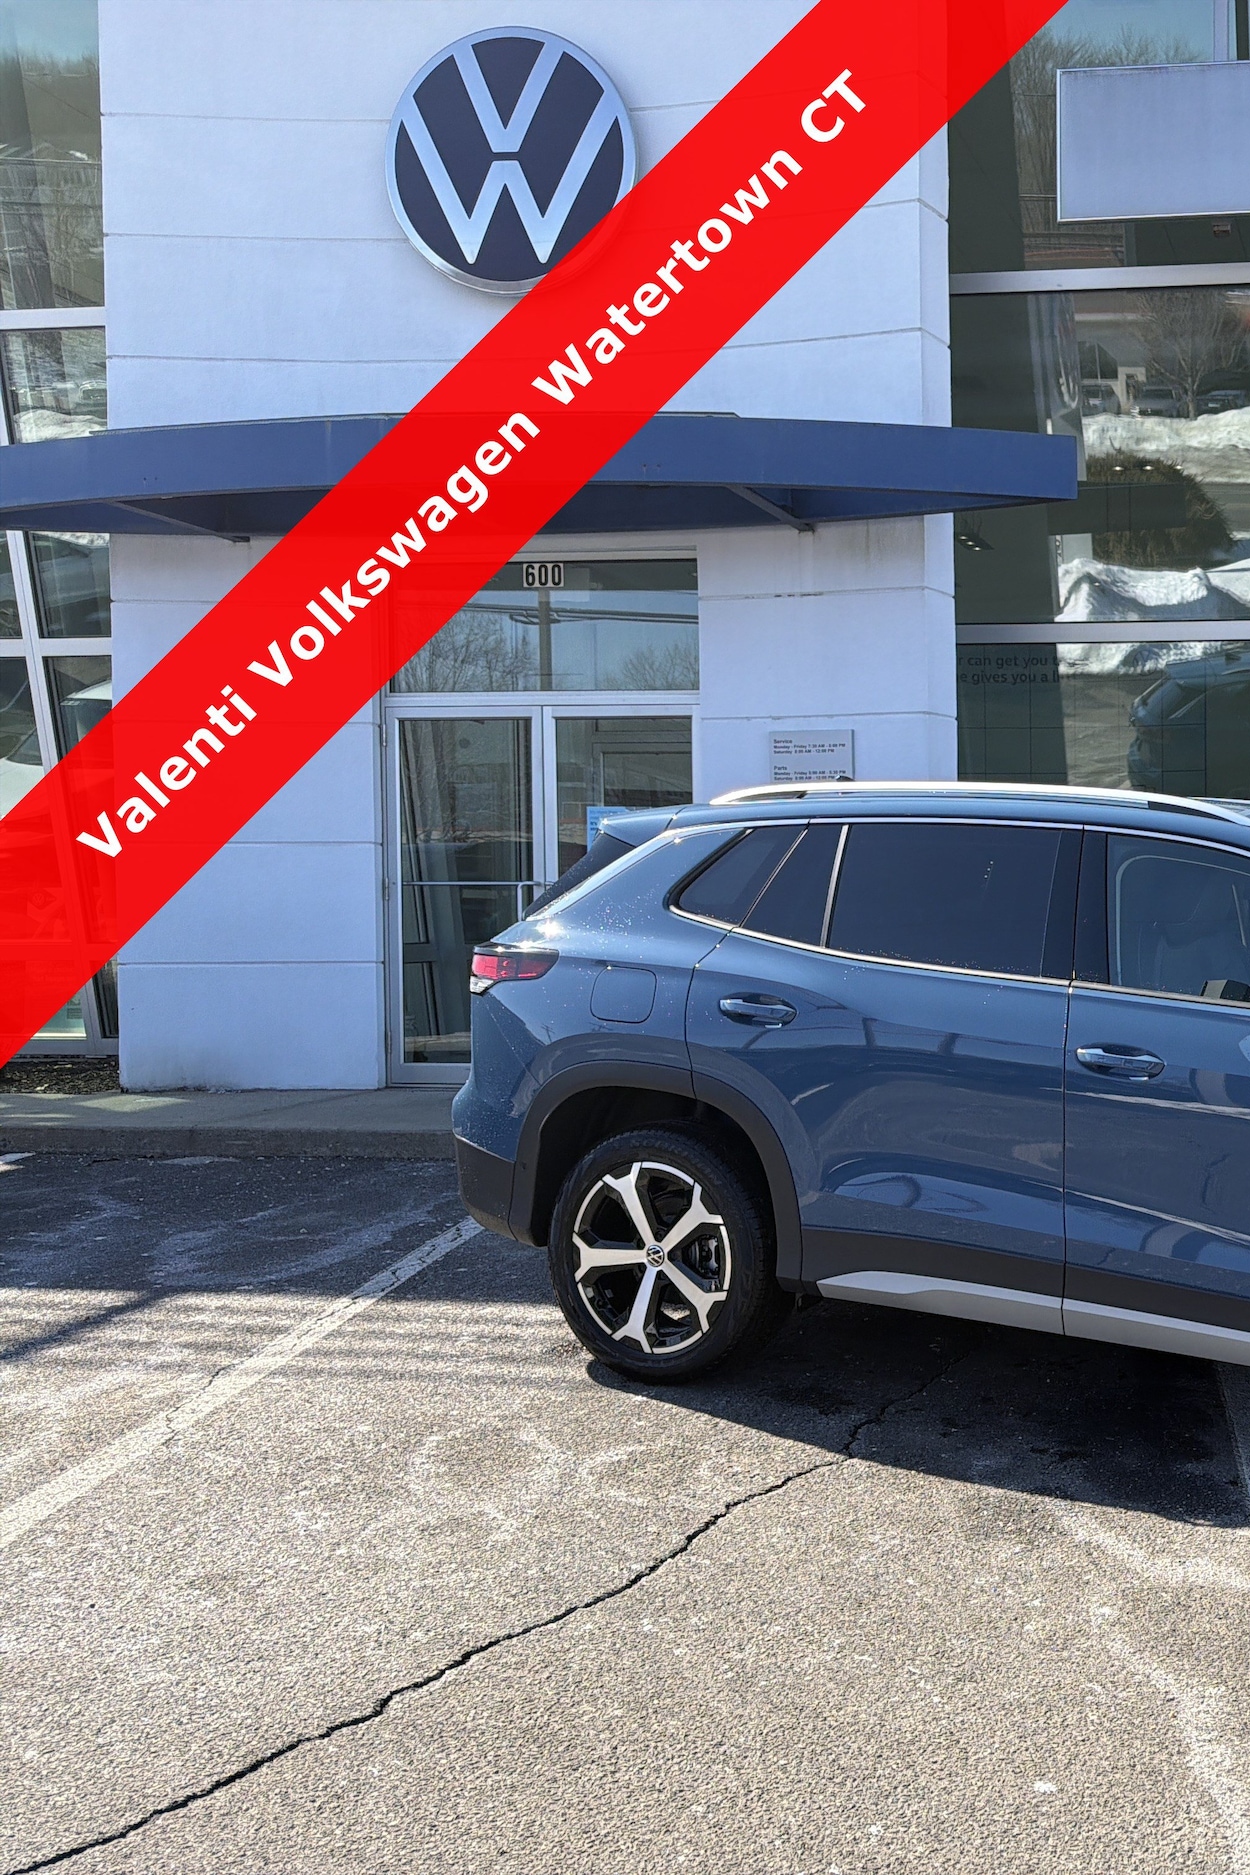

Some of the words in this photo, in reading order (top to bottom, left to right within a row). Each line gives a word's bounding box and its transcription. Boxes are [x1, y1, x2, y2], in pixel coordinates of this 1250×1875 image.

[525, 564, 562, 586] 600
[967, 657, 991, 666] can
[996, 655, 1018, 669] get
[1023, 657, 1046, 669] you
[971, 671, 1007, 685] gives
[1011, 673, 1036, 685] you
[1041, 673, 1048, 682] a
